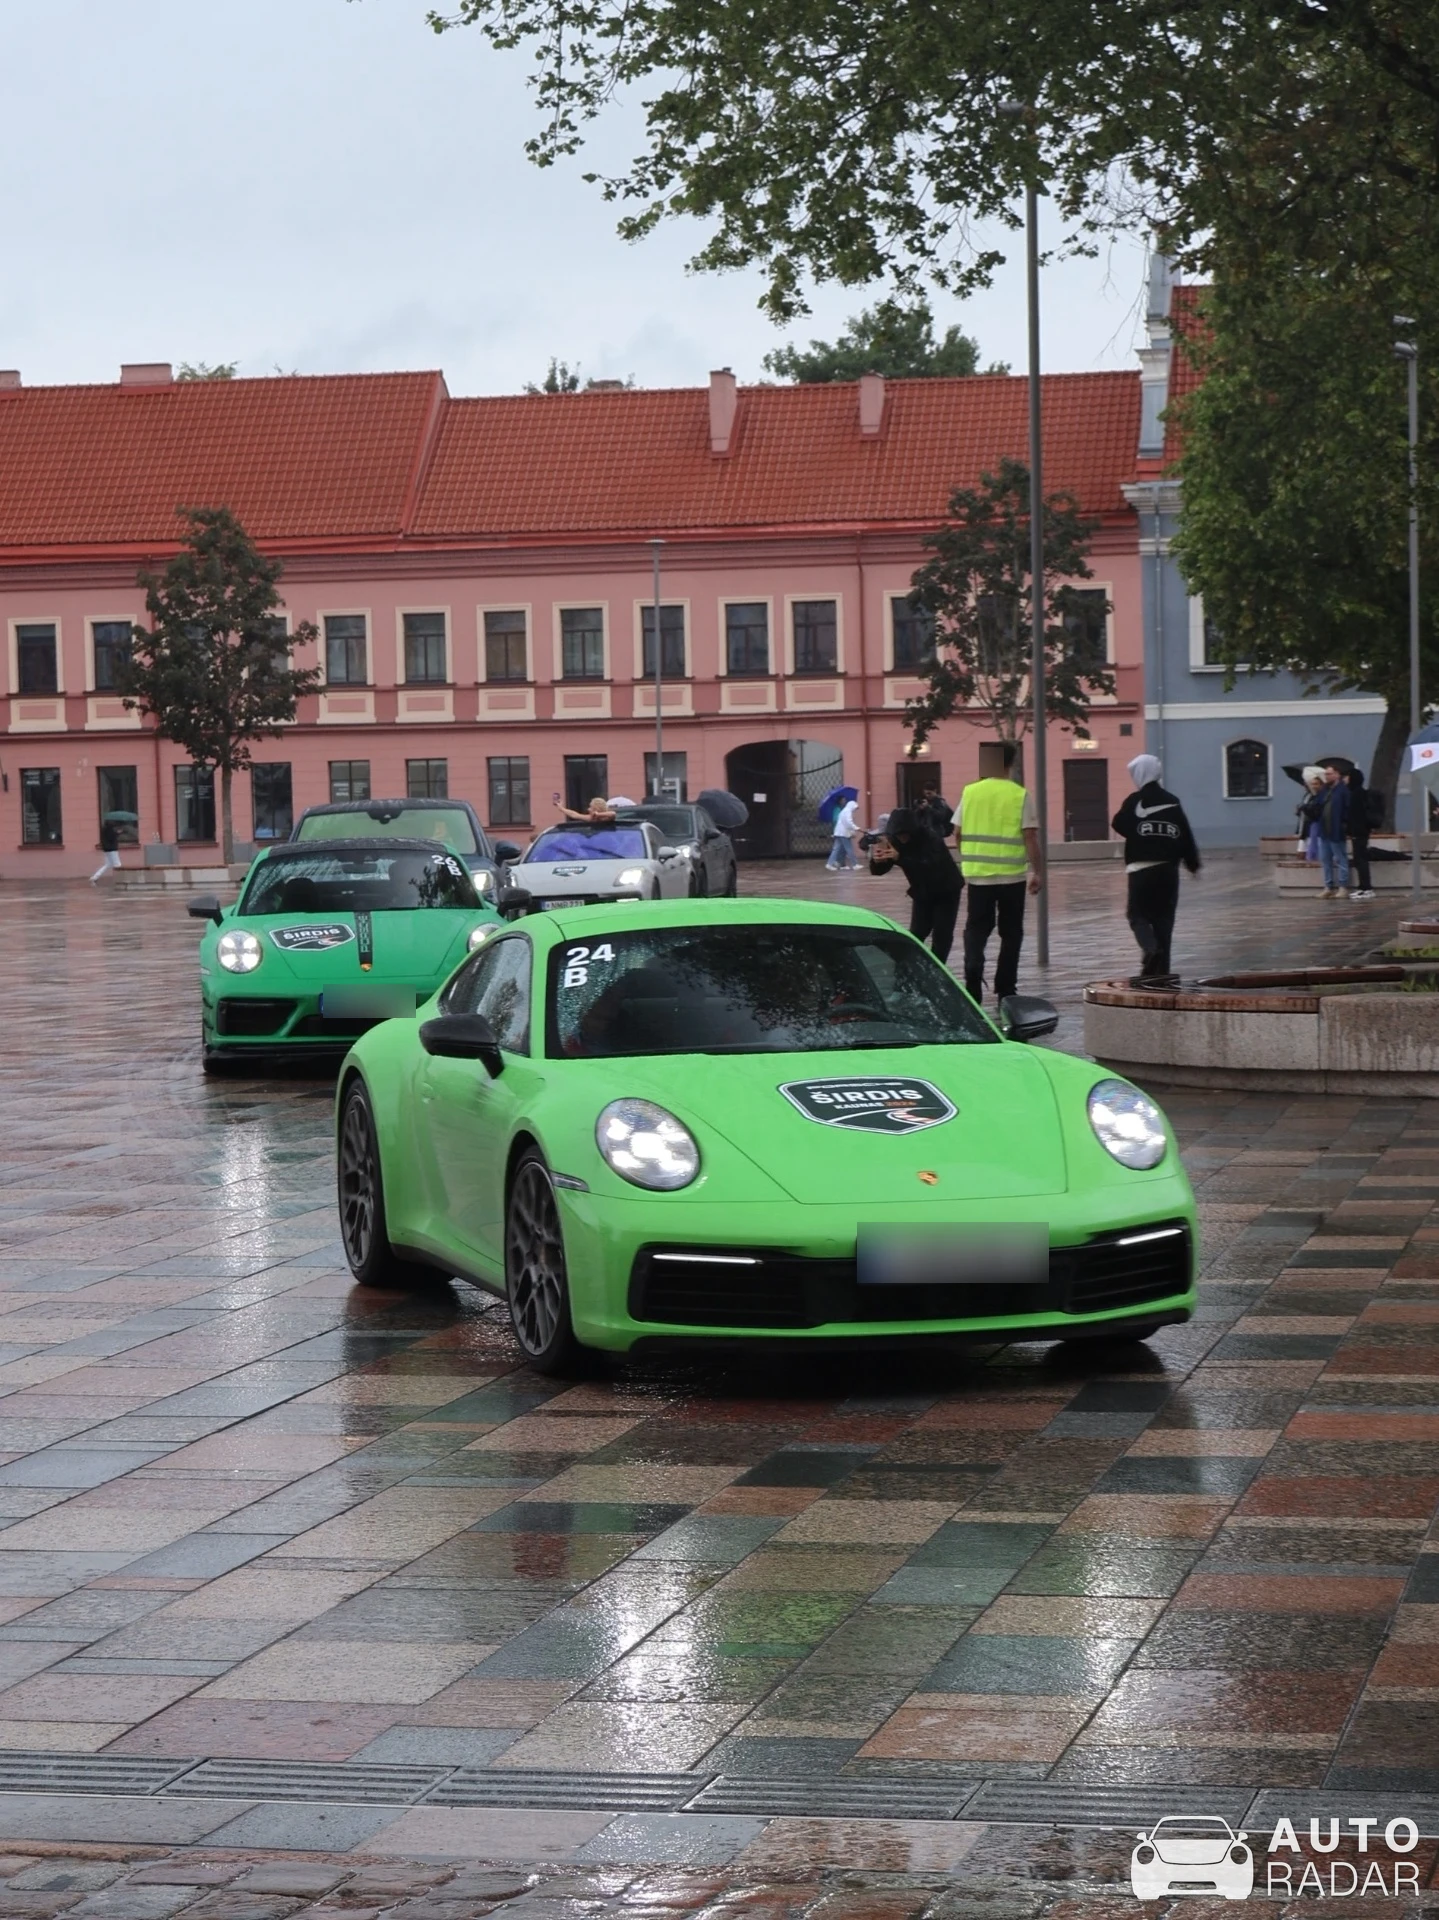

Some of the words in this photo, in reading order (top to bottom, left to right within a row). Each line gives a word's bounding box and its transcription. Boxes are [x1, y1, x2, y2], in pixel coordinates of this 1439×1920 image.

[1141, 823, 1176, 836] AIR
[431, 854, 457, 867] 26
[447, 865, 462, 876] B
[566, 943, 616, 968] 24
[563, 967, 589, 988] B
[809, 1089, 924, 1104] ŠIRDIS
[834, 1101, 885, 1110] KAUNAS
